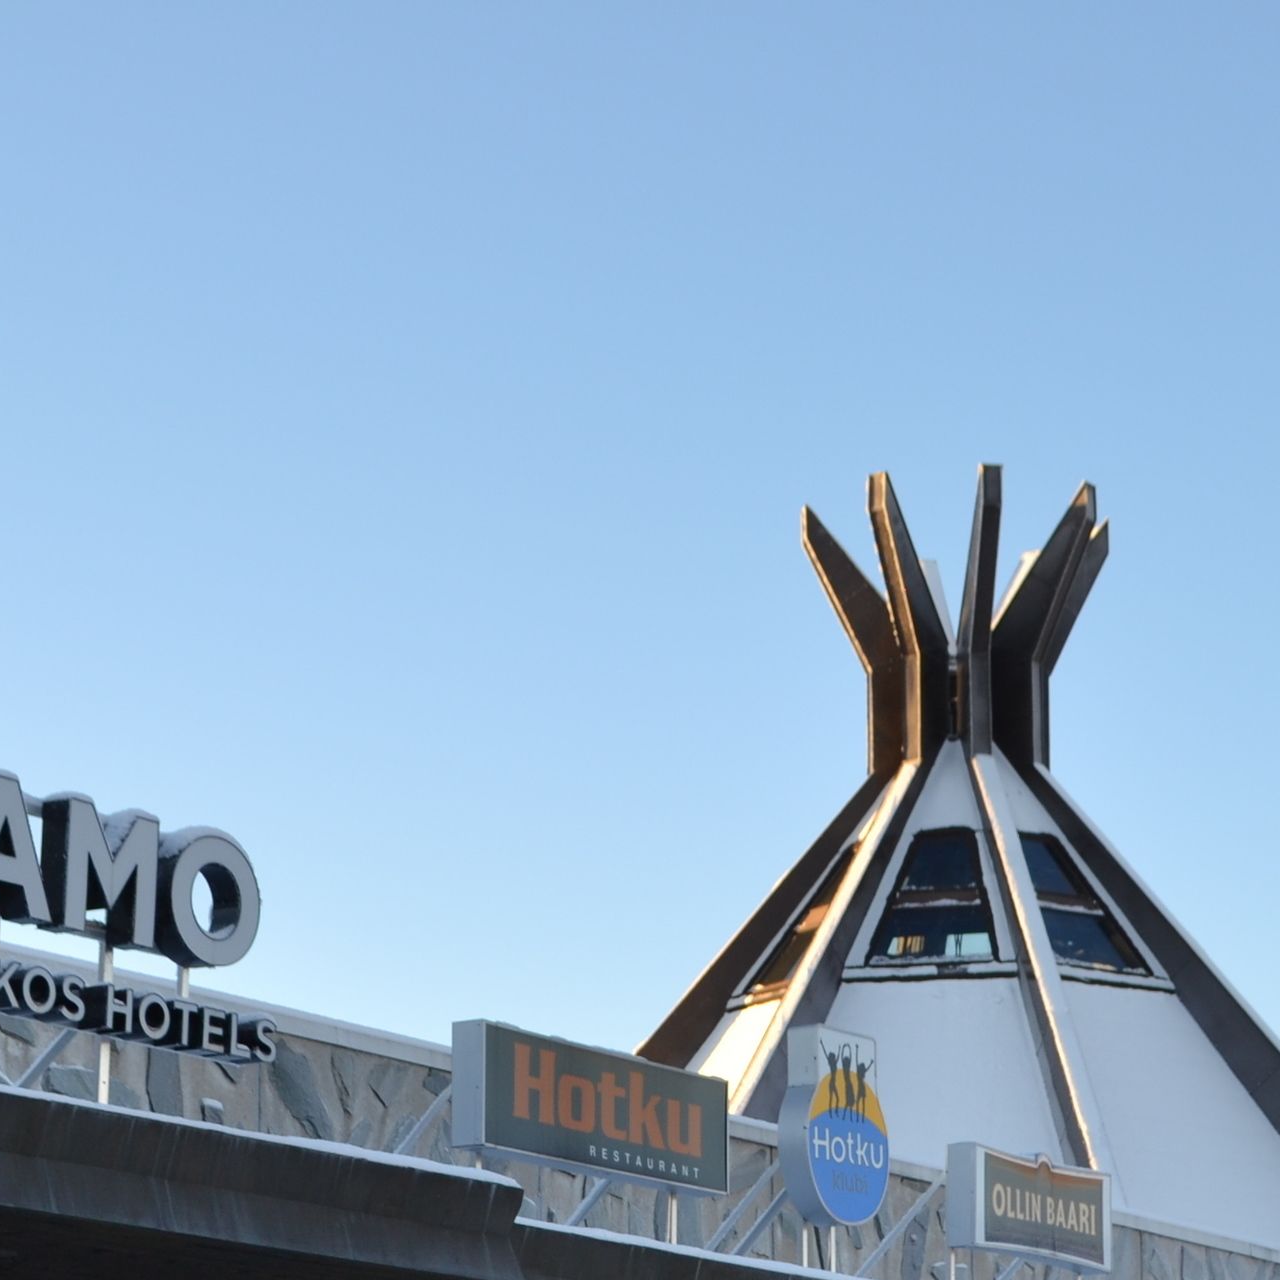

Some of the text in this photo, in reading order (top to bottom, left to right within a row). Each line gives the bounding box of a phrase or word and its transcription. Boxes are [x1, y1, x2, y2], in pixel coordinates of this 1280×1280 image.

[105, 983, 278, 1063] HOTELS
[512, 1042, 702, 1159] Hotku
[589, 1145, 701, 1179] RESTAURANT
[812, 1125, 884, 1169] Hotku
[992, 1183, 1097, 1236] OLLIN BAARI
